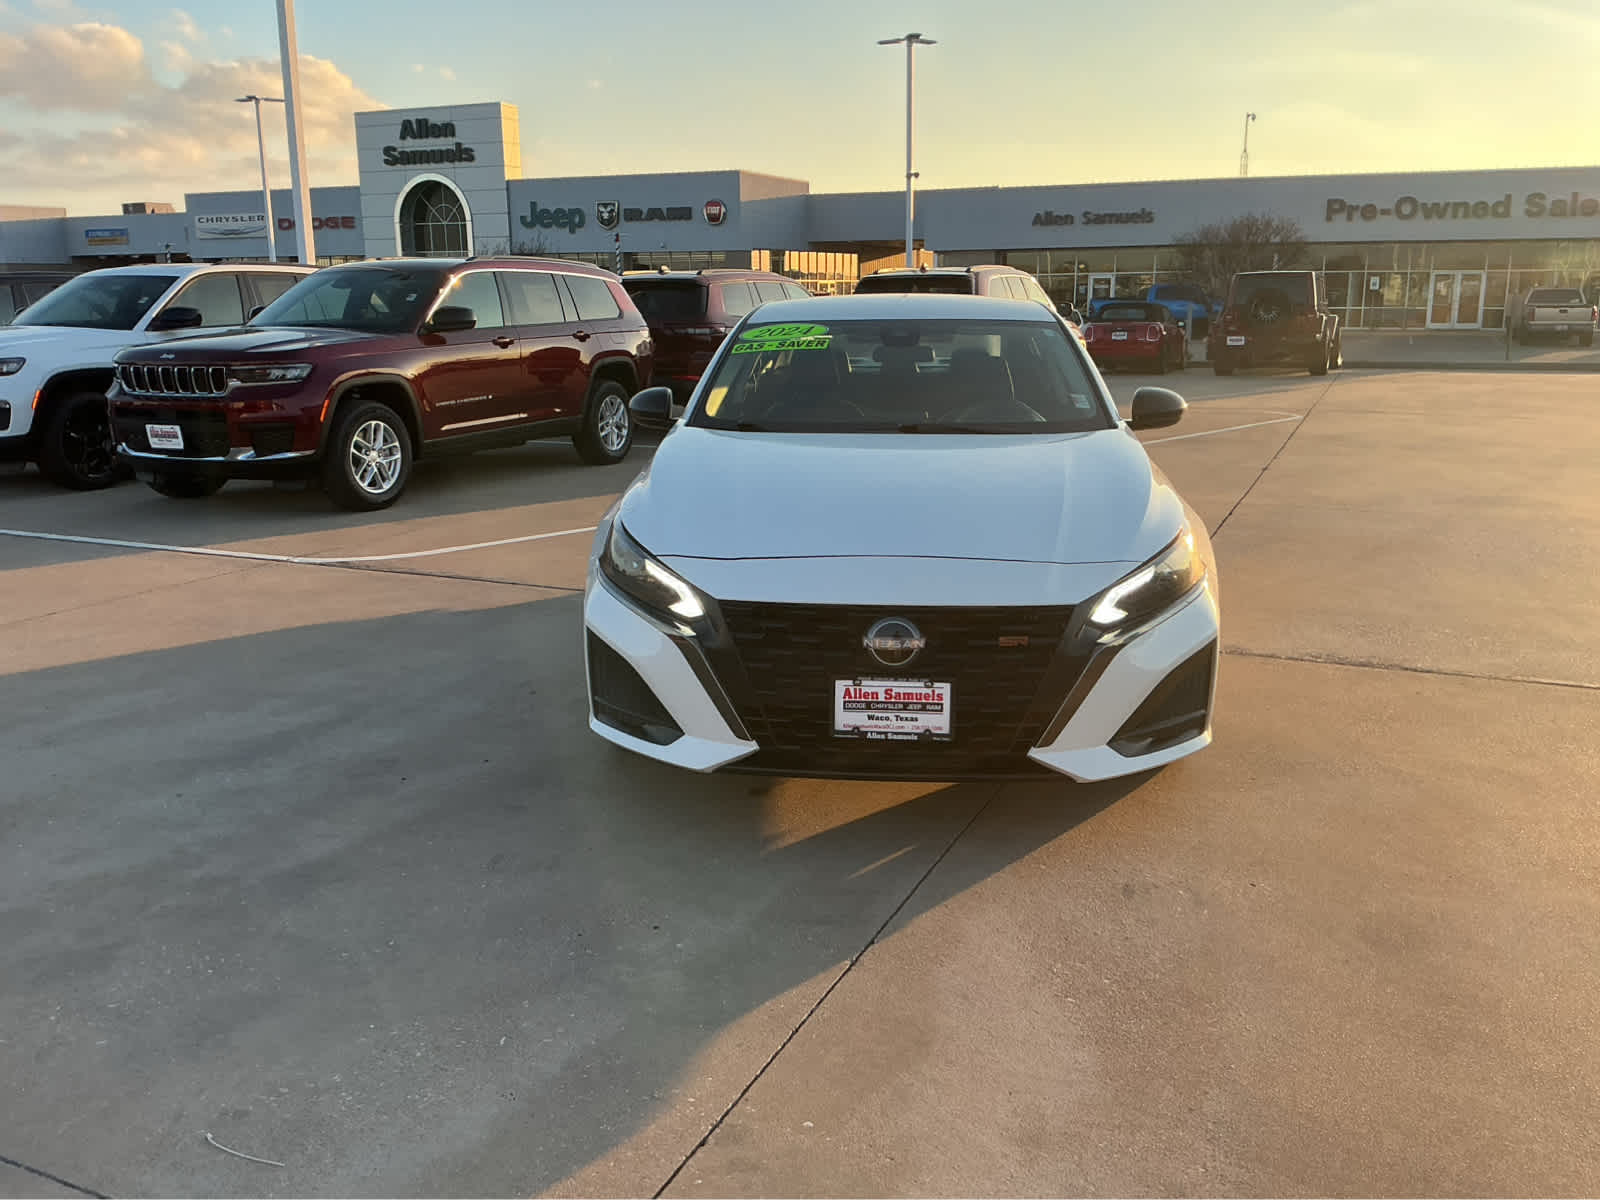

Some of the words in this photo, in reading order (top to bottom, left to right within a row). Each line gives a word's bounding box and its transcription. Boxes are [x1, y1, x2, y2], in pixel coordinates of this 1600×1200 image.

[400, 118, 456, 140] Allen
[382, 142, 475, 166] Samuels
[624, 206, 692, 221] RAM
[1325, 193, 1512, 222] Pre-Owned
[198, 215, 265, 223] CHRYSLER
[519, 201, 586, 234] Jeep
[1032, 211, 1074, 226] Allen
[1082, 207, 1154, 225] Samuels
[863, 639, 926, 649] NISSAN
[843, 687, 879, 701] Allen
[883, 688, 944, 702] Samuels
[870, 702, 903, 710] CHRYSLER
[867, 714, 893, 722] Waco,
[895, 714, 918, 722] Texas
